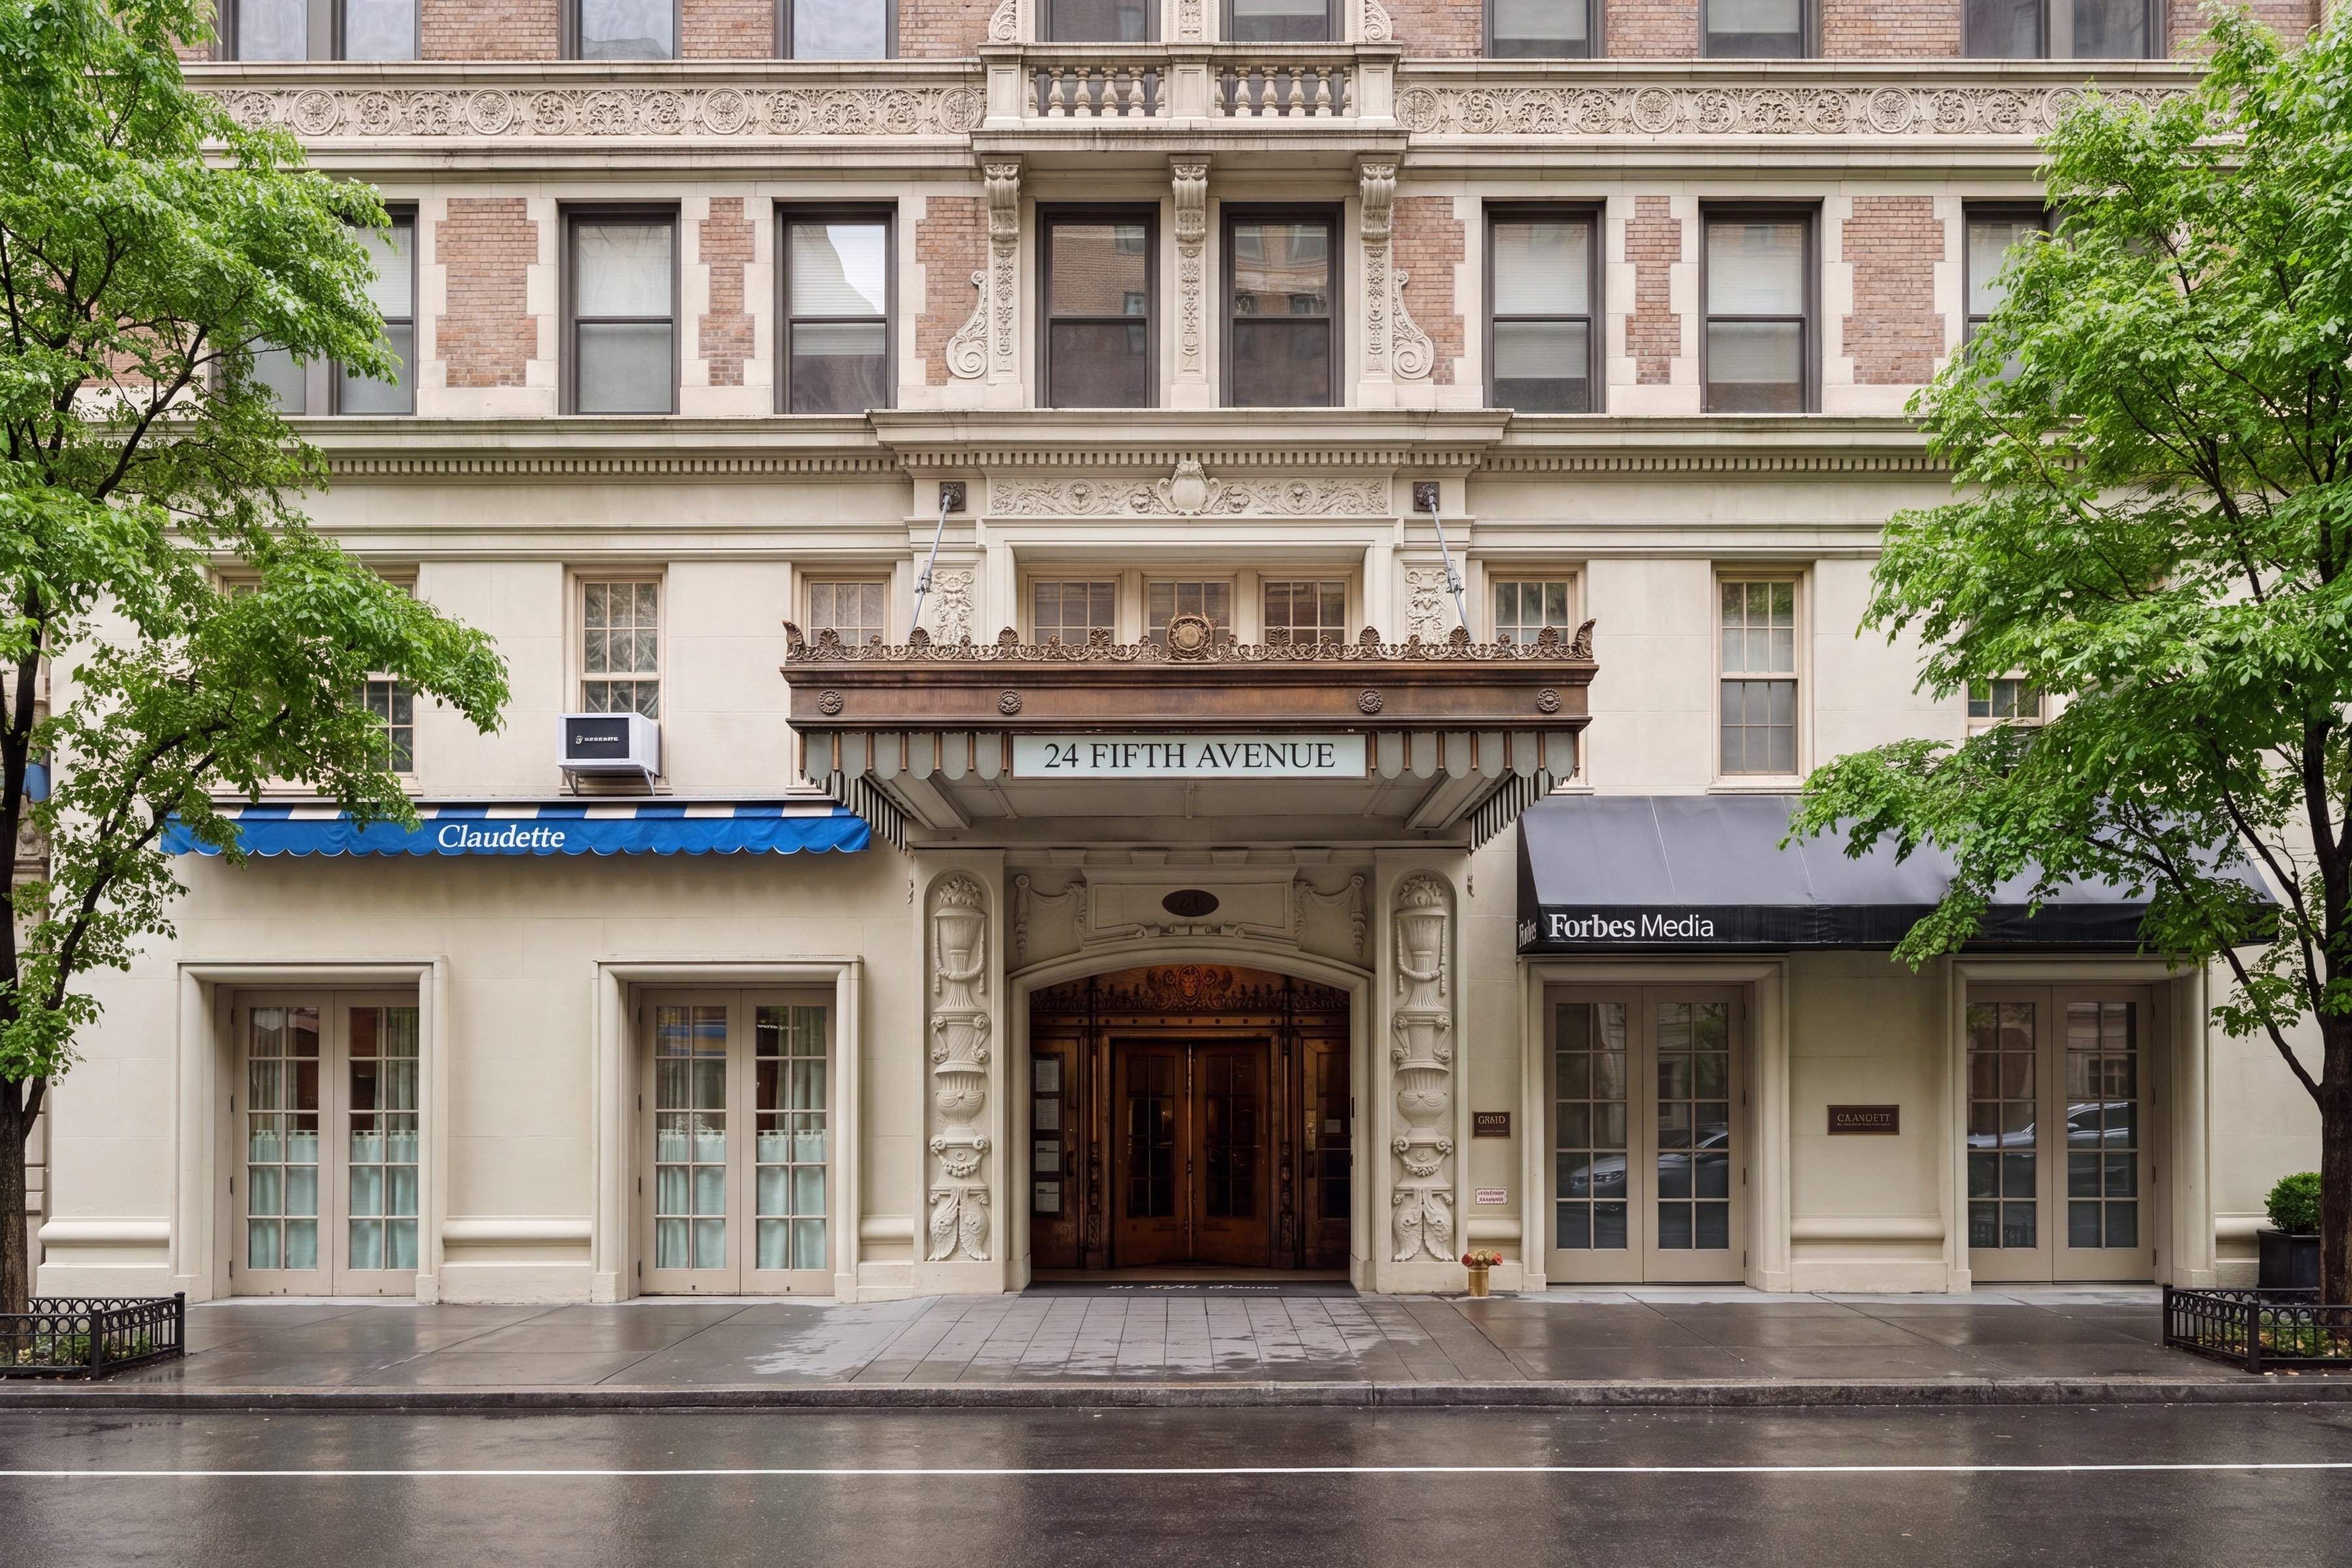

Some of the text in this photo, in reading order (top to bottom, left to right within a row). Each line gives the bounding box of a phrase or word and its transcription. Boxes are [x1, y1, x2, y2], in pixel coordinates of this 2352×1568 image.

[1044, 743, 1336, 768] 24 FIFTH AVENUE
[438, 824, 566, 848] Claudette
[1548, 913, 1714, 938] Forbes Media
